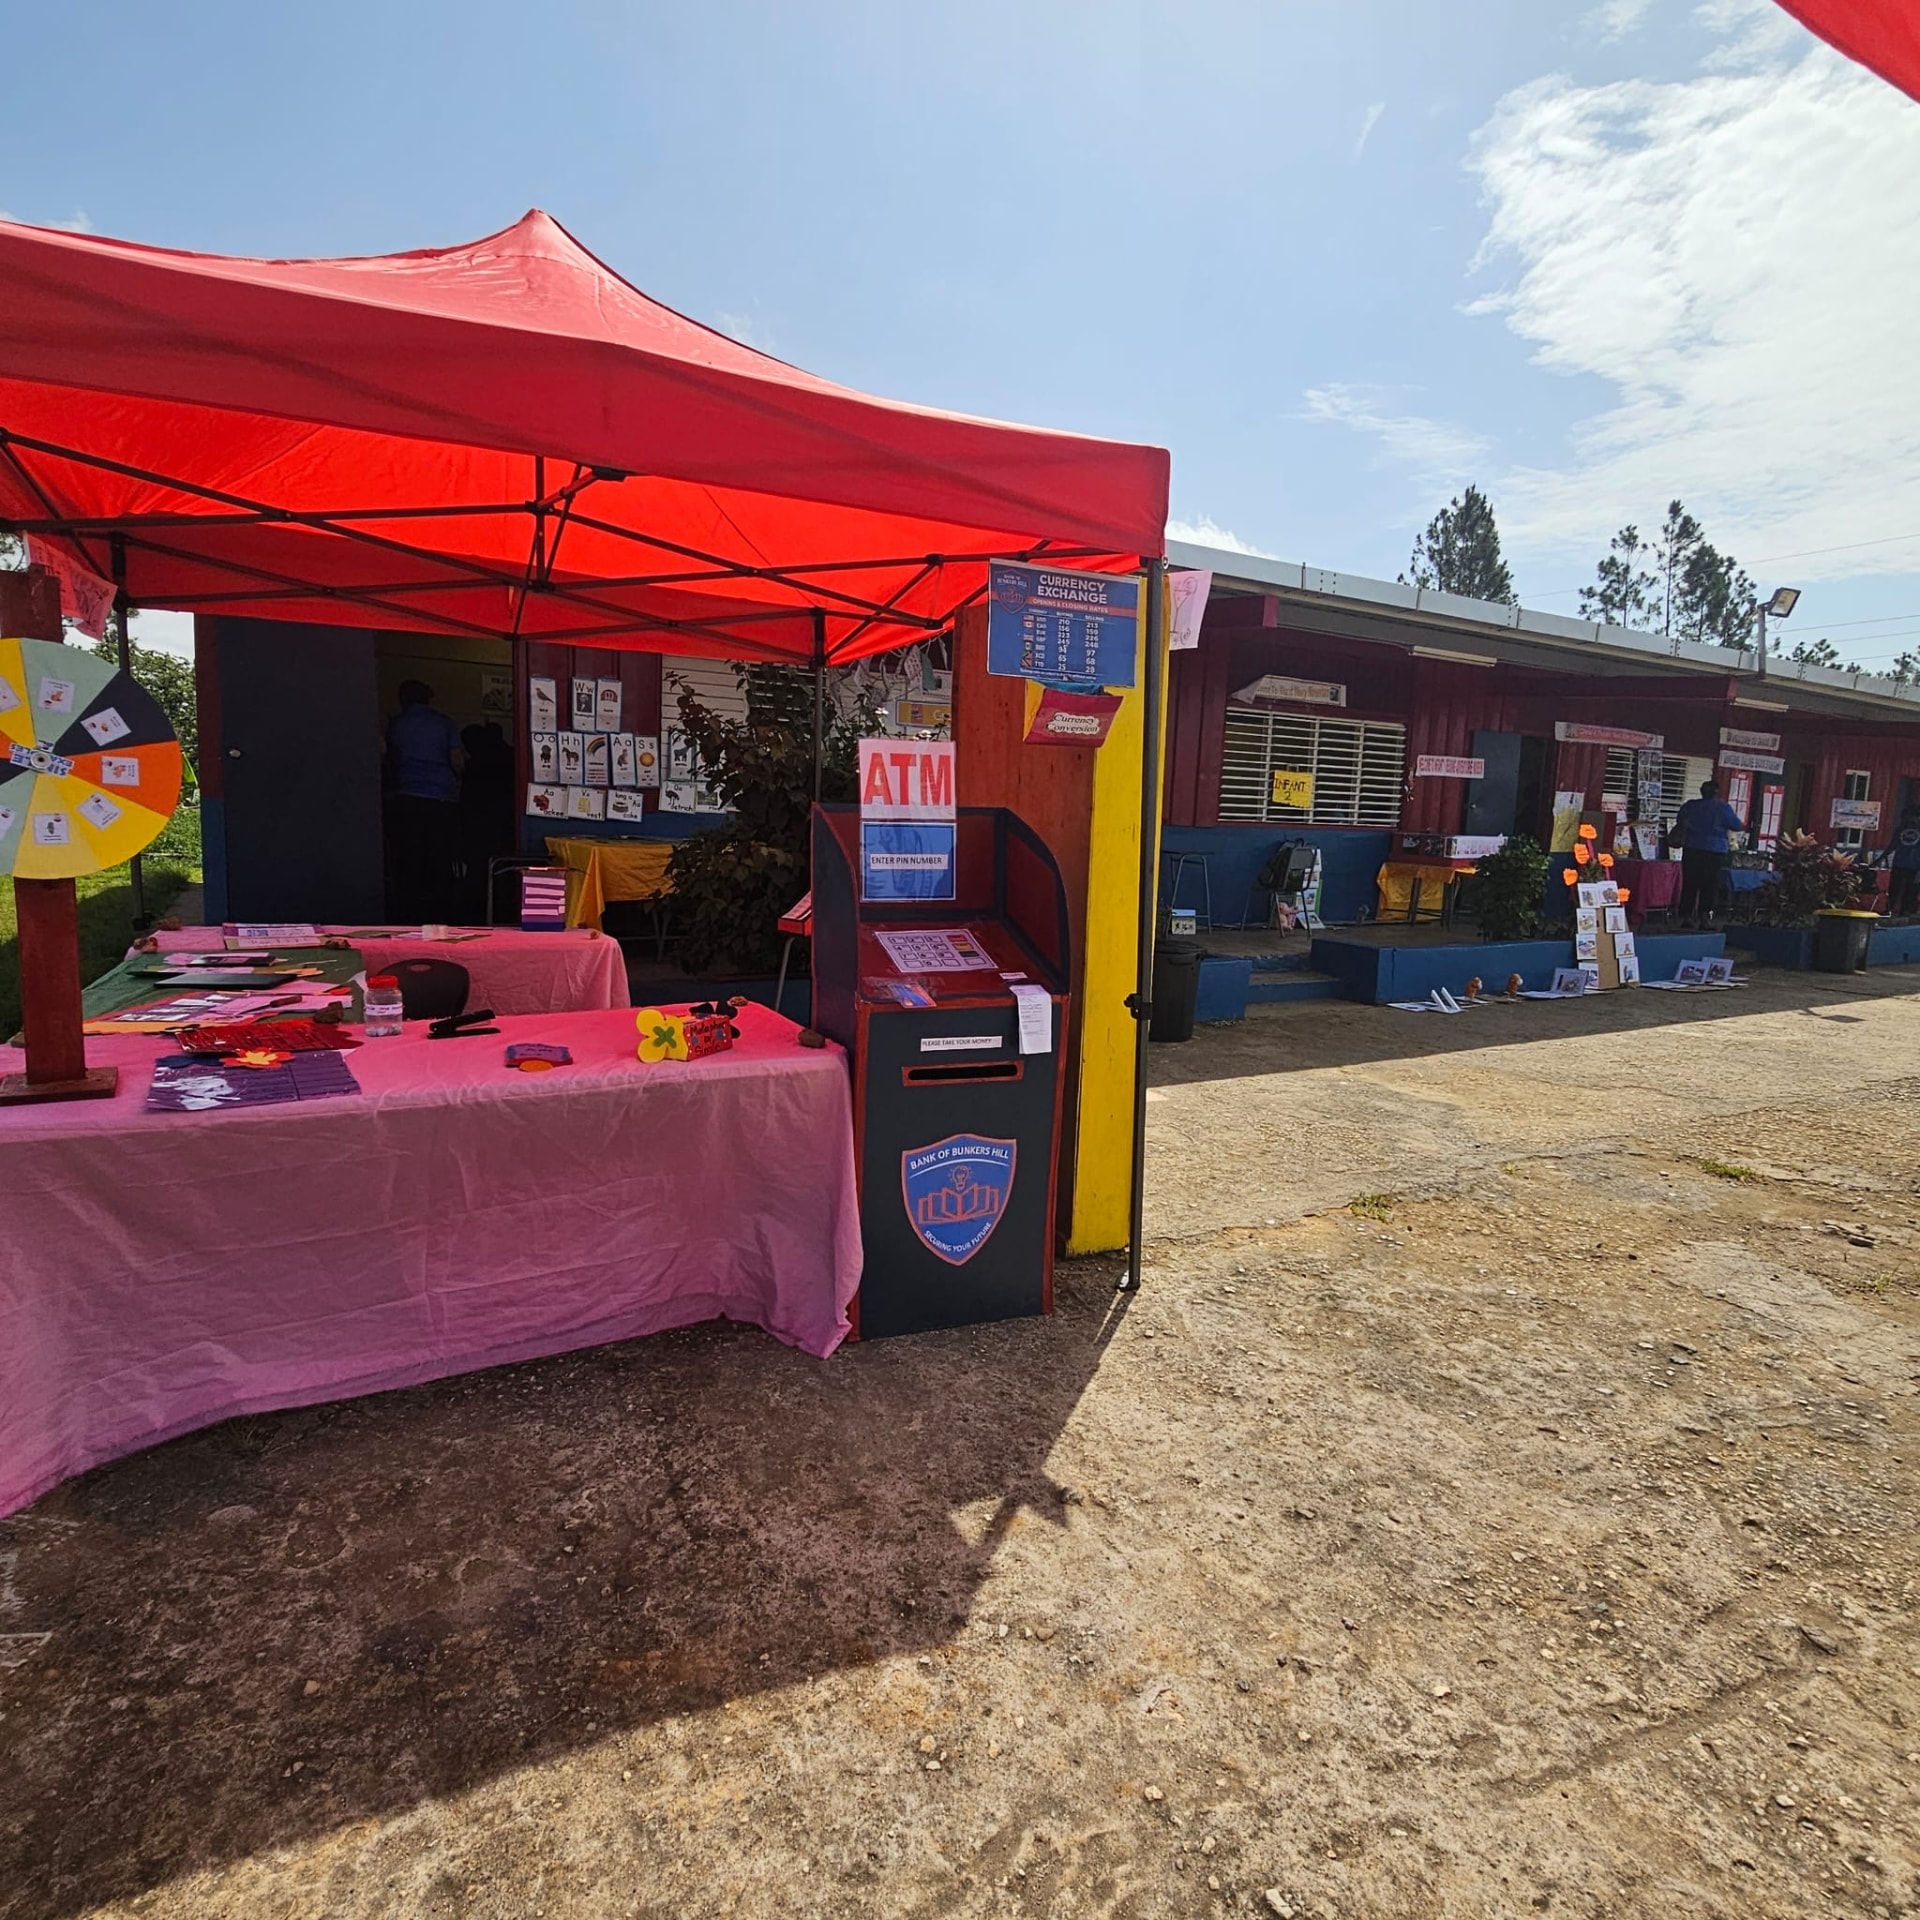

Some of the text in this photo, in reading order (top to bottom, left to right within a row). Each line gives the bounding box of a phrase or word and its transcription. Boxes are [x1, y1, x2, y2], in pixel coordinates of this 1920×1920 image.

[1039, 574, 1106, 592] CURRENCY
[1037, 585, 1108, 604] EXCHANGE
[1032, 598, 1056, 607] OPENING
[1061, 602, 1089, 611] CLOSING
[1089, 606, 1109, 614] RATES
[575, 682, 585, 692] W
[1053, 714, 1095, 725] Currency
[1046, 723, 1098, 733] Conversion
[561, 736, 580, 746] H h
[613, 737, 621, 747] A
[638, 740, 645, 749] S
[863, 752, 952, 806] ATM
[1274, 778, 1306, 792] INFANT
[543, 788, 554, 797] Aa
[1284, 790, 1292, 801] 2
[543, 809, 564, 817] ackee
[871, 857, 942, 865] ENTER PIN NUMBER
[922, 1039, 941, 1047] PLEASE
[910, 1146, 1009, 1170] BANK OF BUNKERS HILL
[924, 1221, 992, 1253] SECURING YOUR FUTURE
